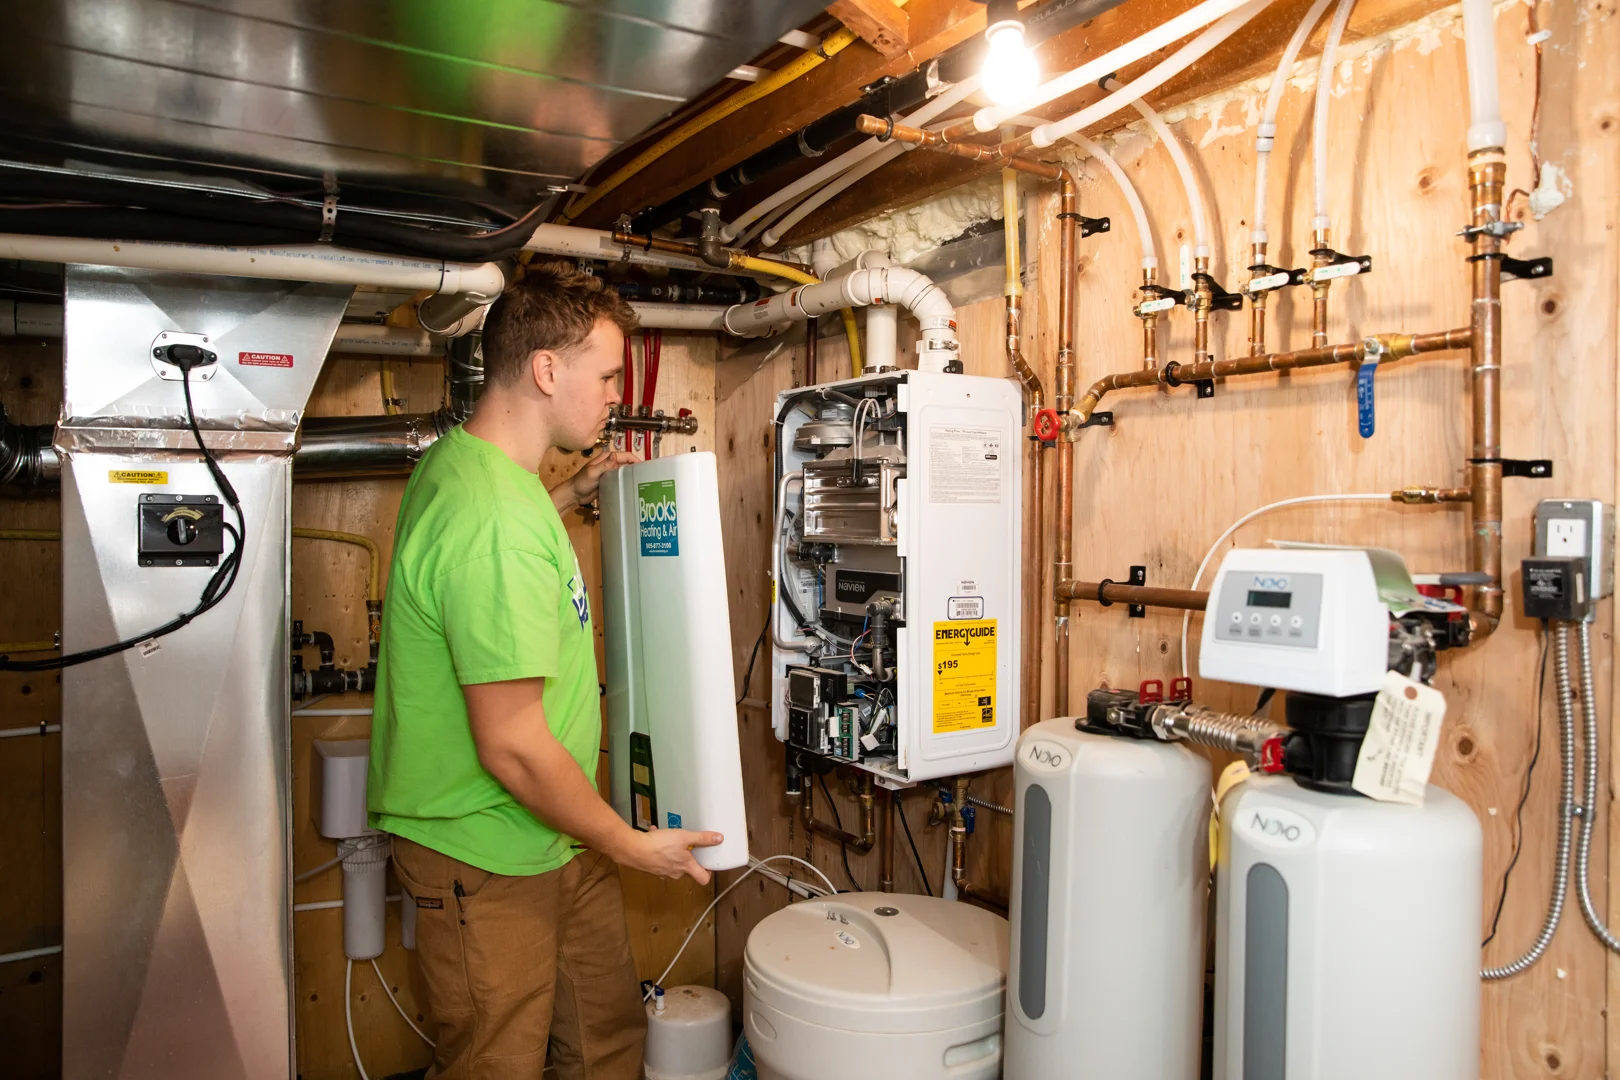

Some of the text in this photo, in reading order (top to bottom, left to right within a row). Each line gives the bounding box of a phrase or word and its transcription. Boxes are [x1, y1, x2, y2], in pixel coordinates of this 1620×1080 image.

[639, 494, 677, 522] Brooks
[640, 523, 677, 540] Heating & Air
[1253, 575, 1288, 590] NOVO
[935, 626, 996, 641] ENERGYGUIDE
[937, 659, 959, 670] $195
[1417, 711, 1432, 757] IMPORTANT
[1029, 744, 1062, 767] NOVO
[1251, 811, 1301, 842] NOVO
